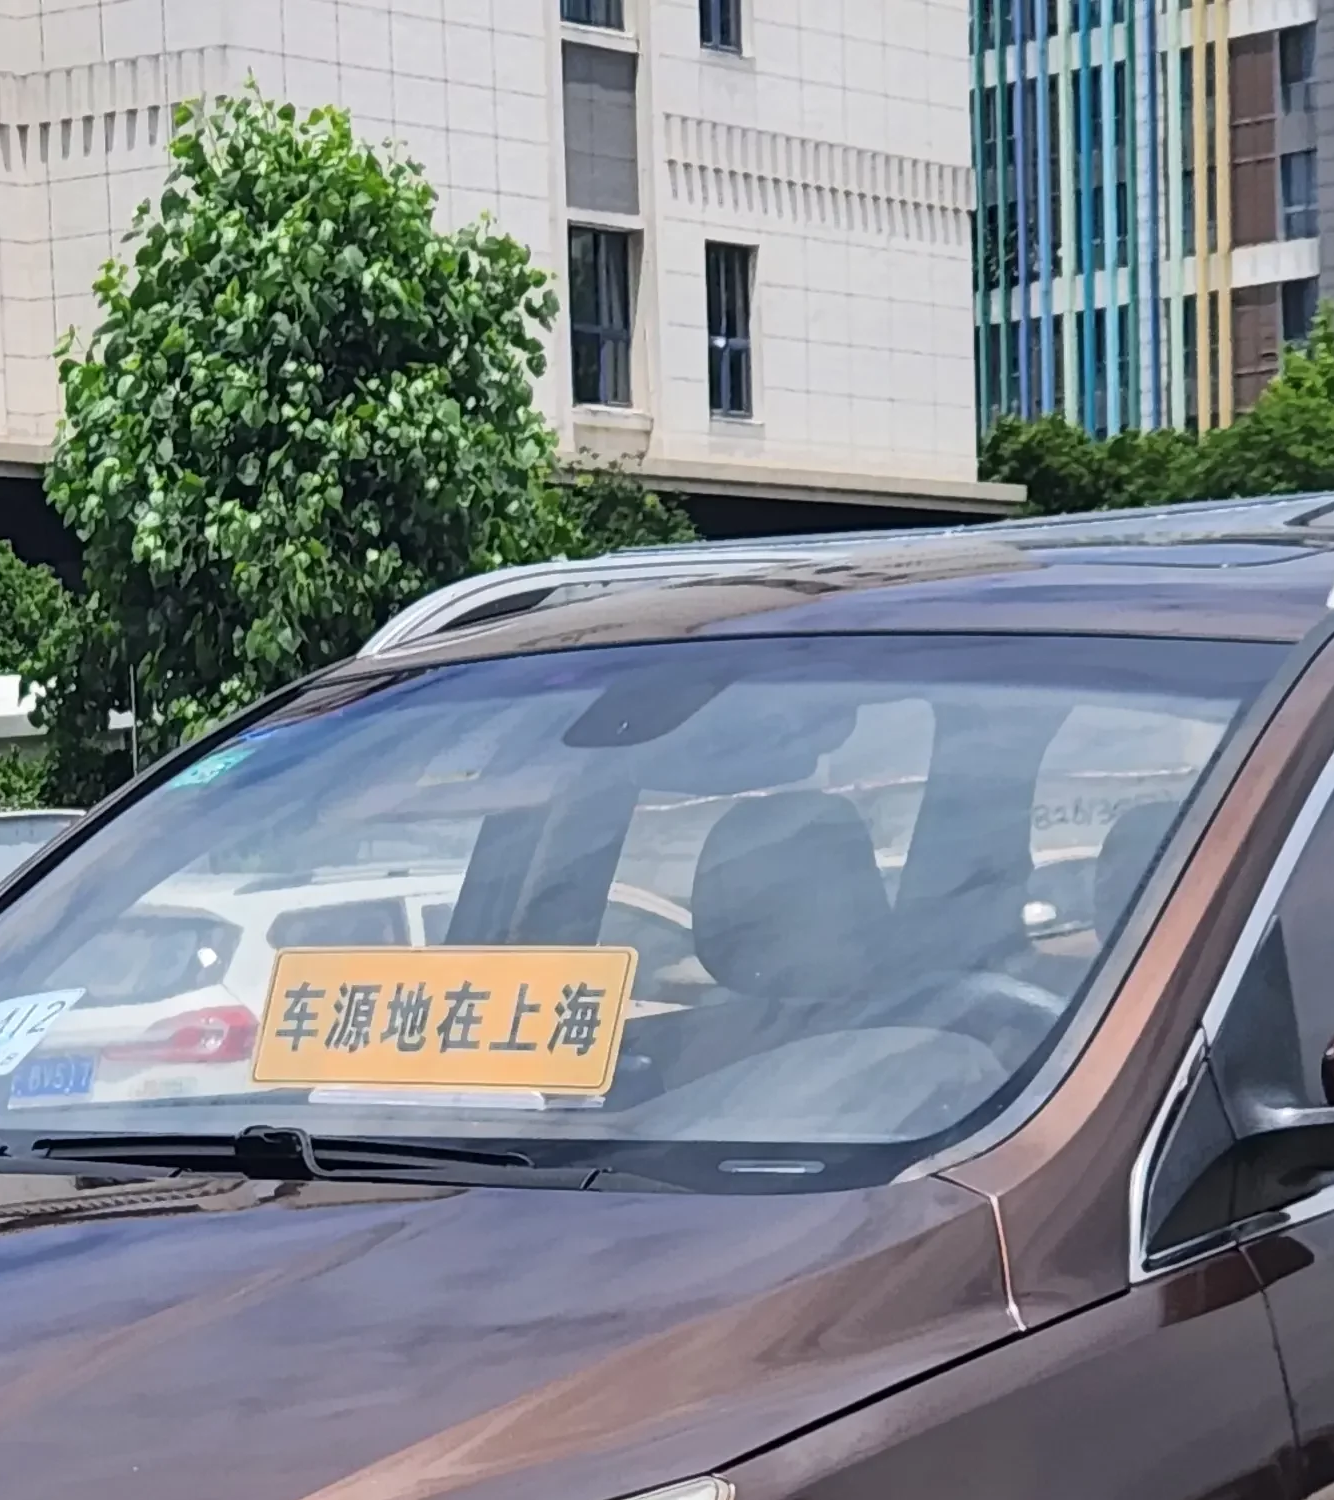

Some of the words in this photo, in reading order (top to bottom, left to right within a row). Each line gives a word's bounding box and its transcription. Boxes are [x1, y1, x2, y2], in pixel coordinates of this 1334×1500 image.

[275, 980, 607, 1057] 车源地在上海
